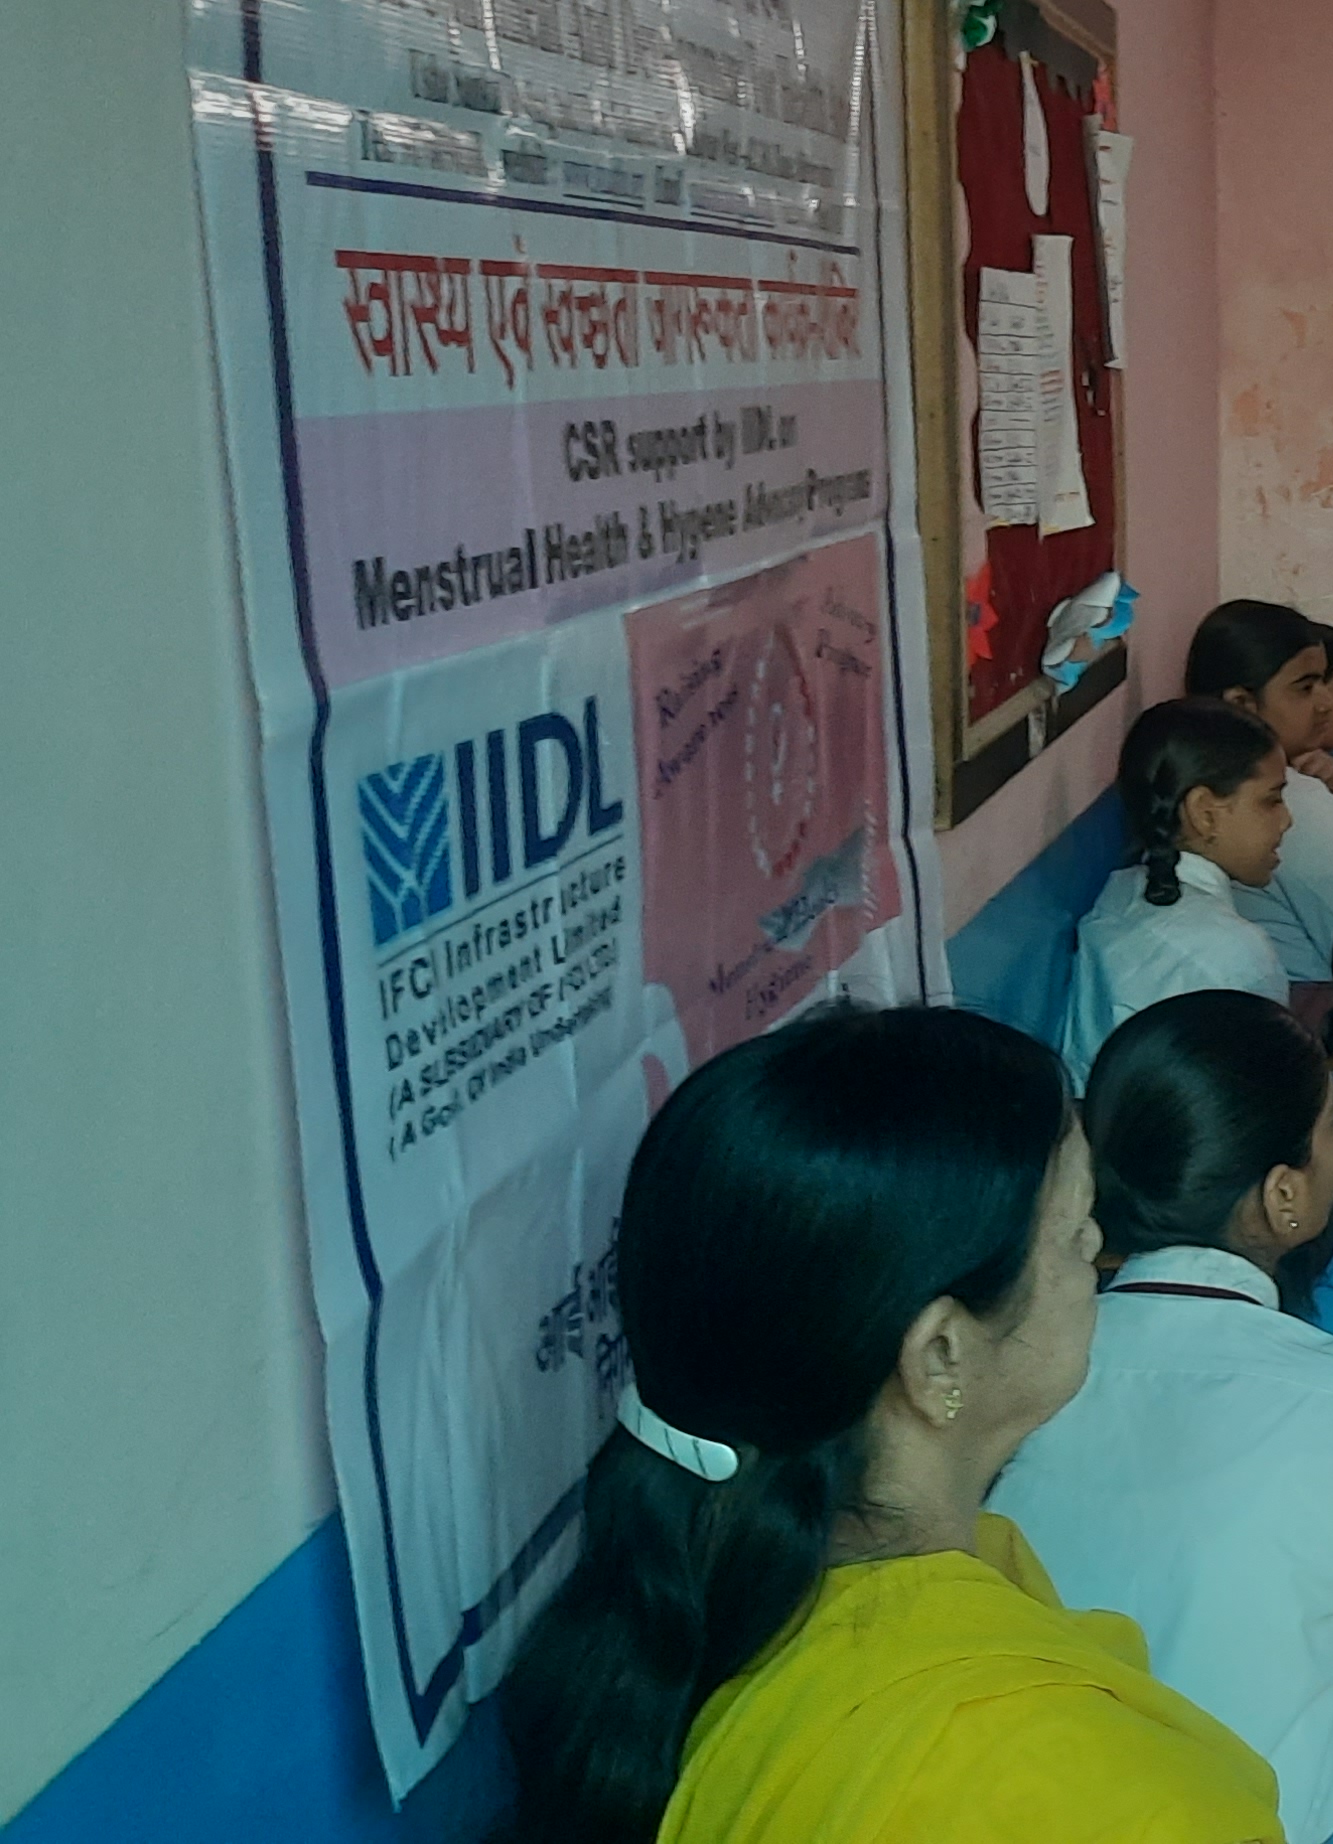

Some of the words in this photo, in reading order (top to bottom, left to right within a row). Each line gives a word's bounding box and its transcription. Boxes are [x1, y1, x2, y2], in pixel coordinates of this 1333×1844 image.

[564, 419, 622, 482] CSR
[353, 528, 539, 630] Menstrual
[544, 511, 629, 585] Health
[454, 695, 624, 902] IIDL
[379, 949, 440, 1021] IFCI
